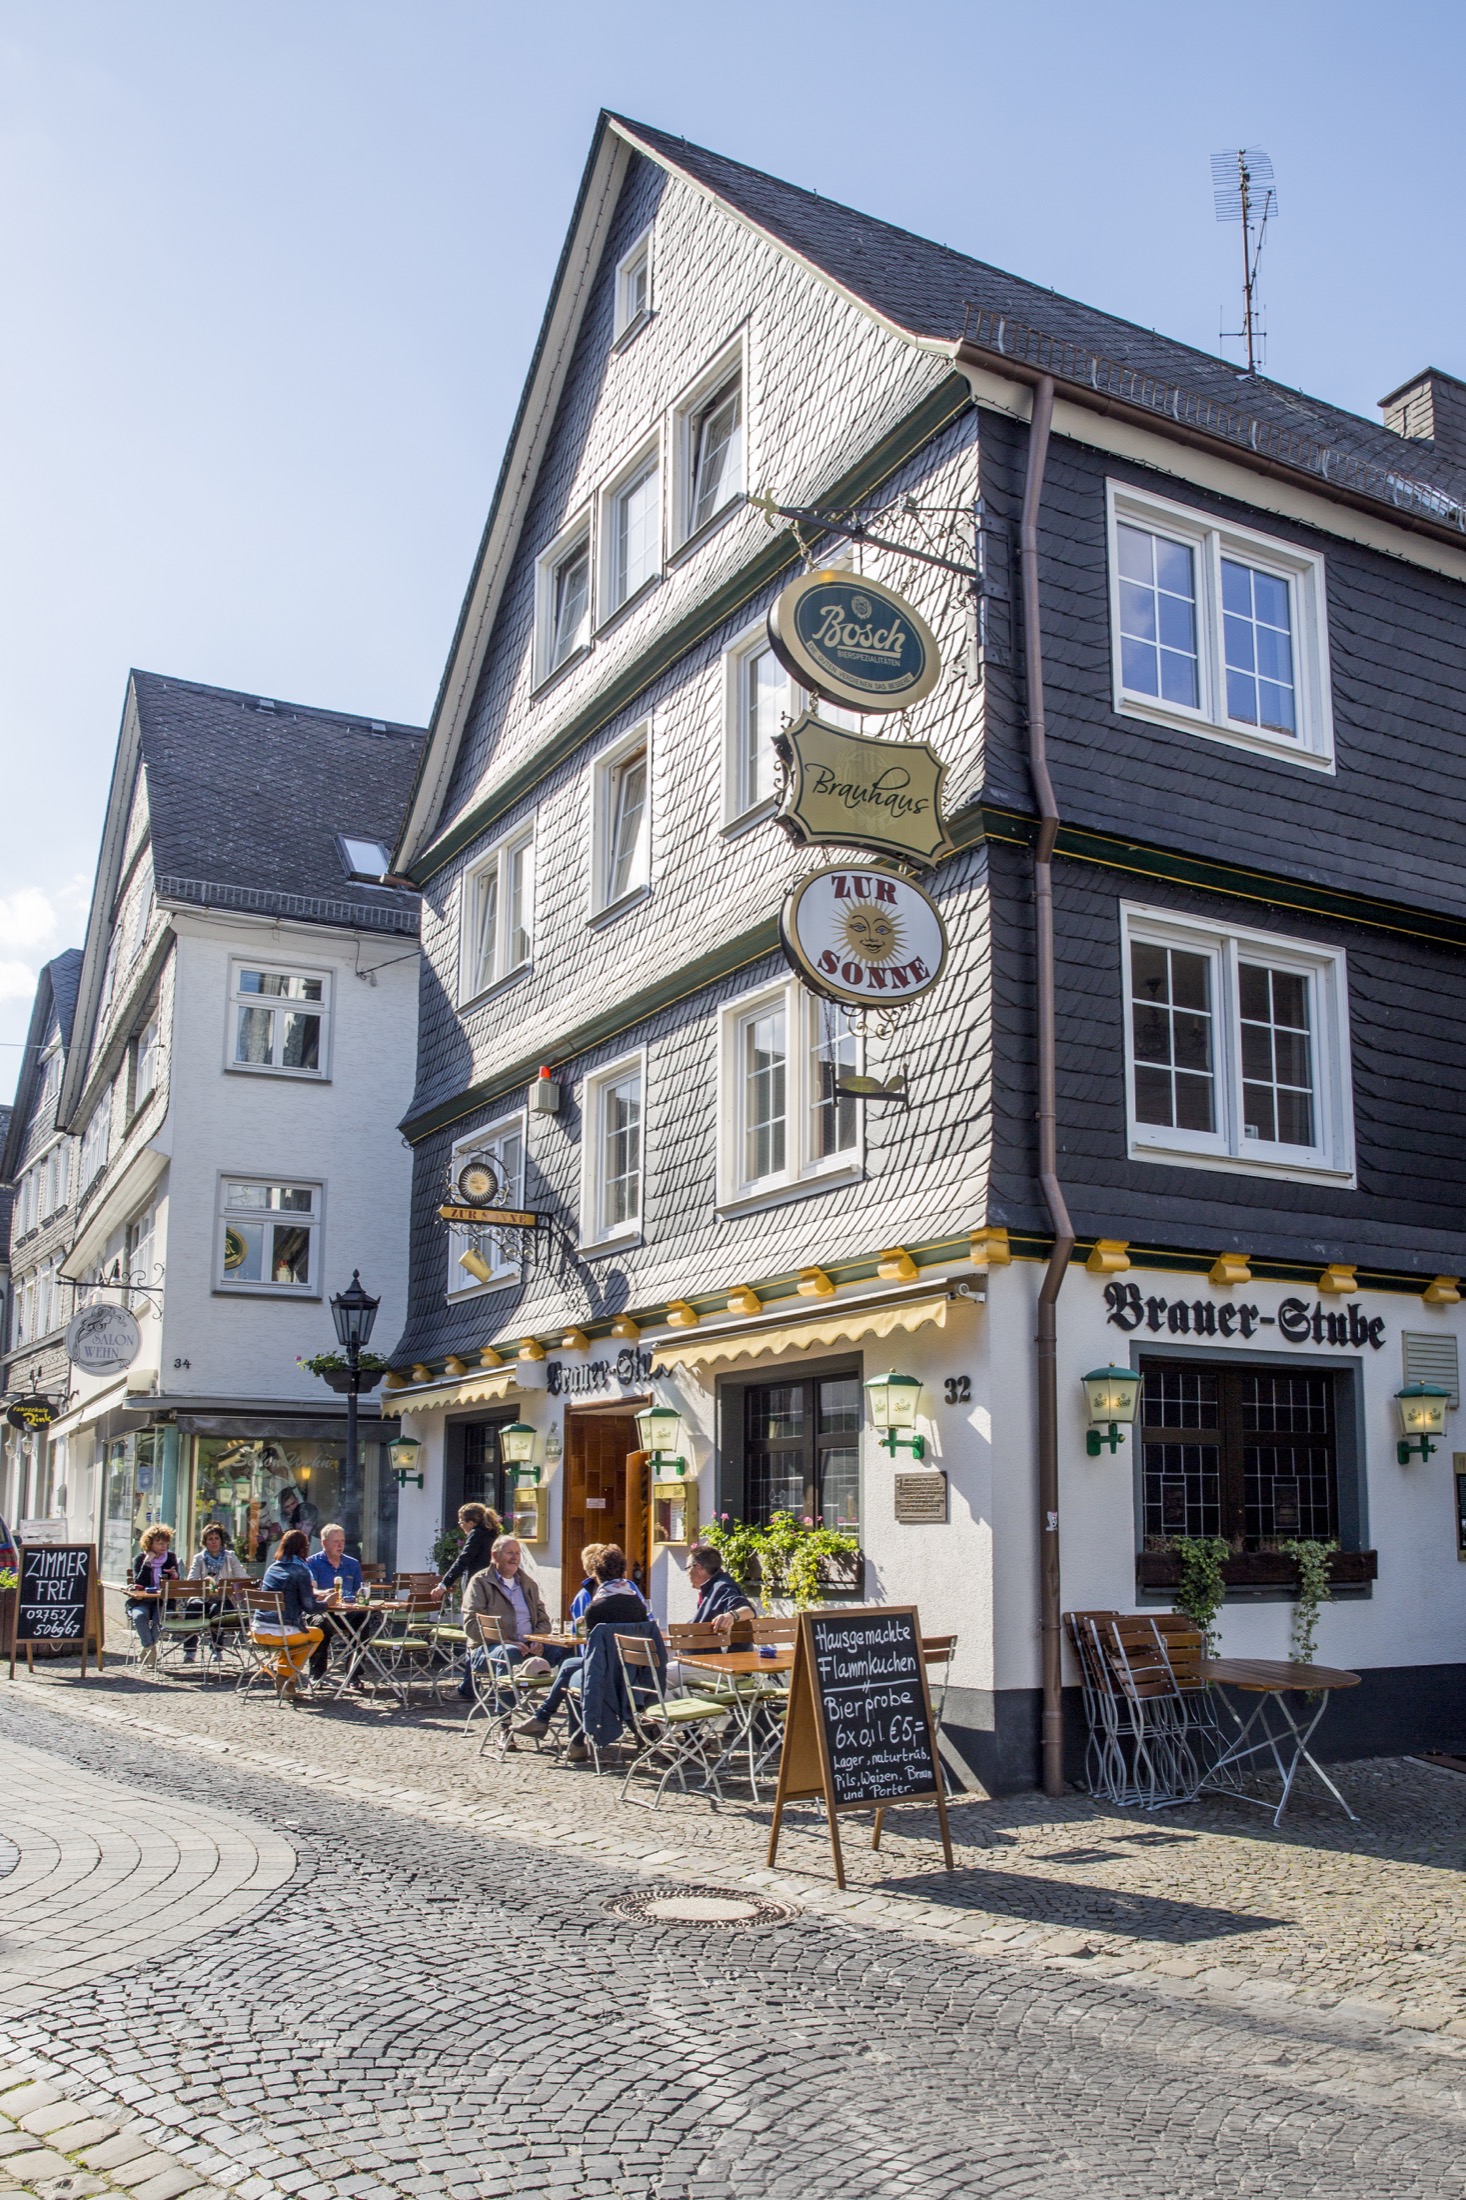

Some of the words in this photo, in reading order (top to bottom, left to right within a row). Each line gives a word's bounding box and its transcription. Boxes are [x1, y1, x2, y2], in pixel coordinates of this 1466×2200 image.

[812, 604, 907, 652] Bosch
[837, 650, 901, 667] BIERSPEZIALITÄTEN
[804, 763, 930, 818] Brauhaus
[831, 875, 898, 905] ZUR
[817, 949, 931, 990] SONNE
[450, 1208, 478, 1220] ZUR
[481, 1210, 527, 1225] SONNE
[1103, 1281, 1387, 1350] Brauer-Stube
[84, 1346, 120, 1359] WEHN
[92, 1333, 135, 1347] SALON
[173, 1358, 192, 1370] 34
[547, 1347, 674, 1396] Brauer-Stu
[944, 1375, 971, 1405] 32
[12, 1405, 49, 1413] Fahrschule
[26, 1608, 78, 1626] 02752/
[33, 1620, 81, 1638] 506967
[815, 1620, 911, 1653] Hausgemachte
[817, 1651, 917, 1682] Flammkuchen
[823, 1691, 914, 1723] Bierprobe
[843, 1788, 864, 1800] und
[868, 1783, 915, 1798] Porter.
